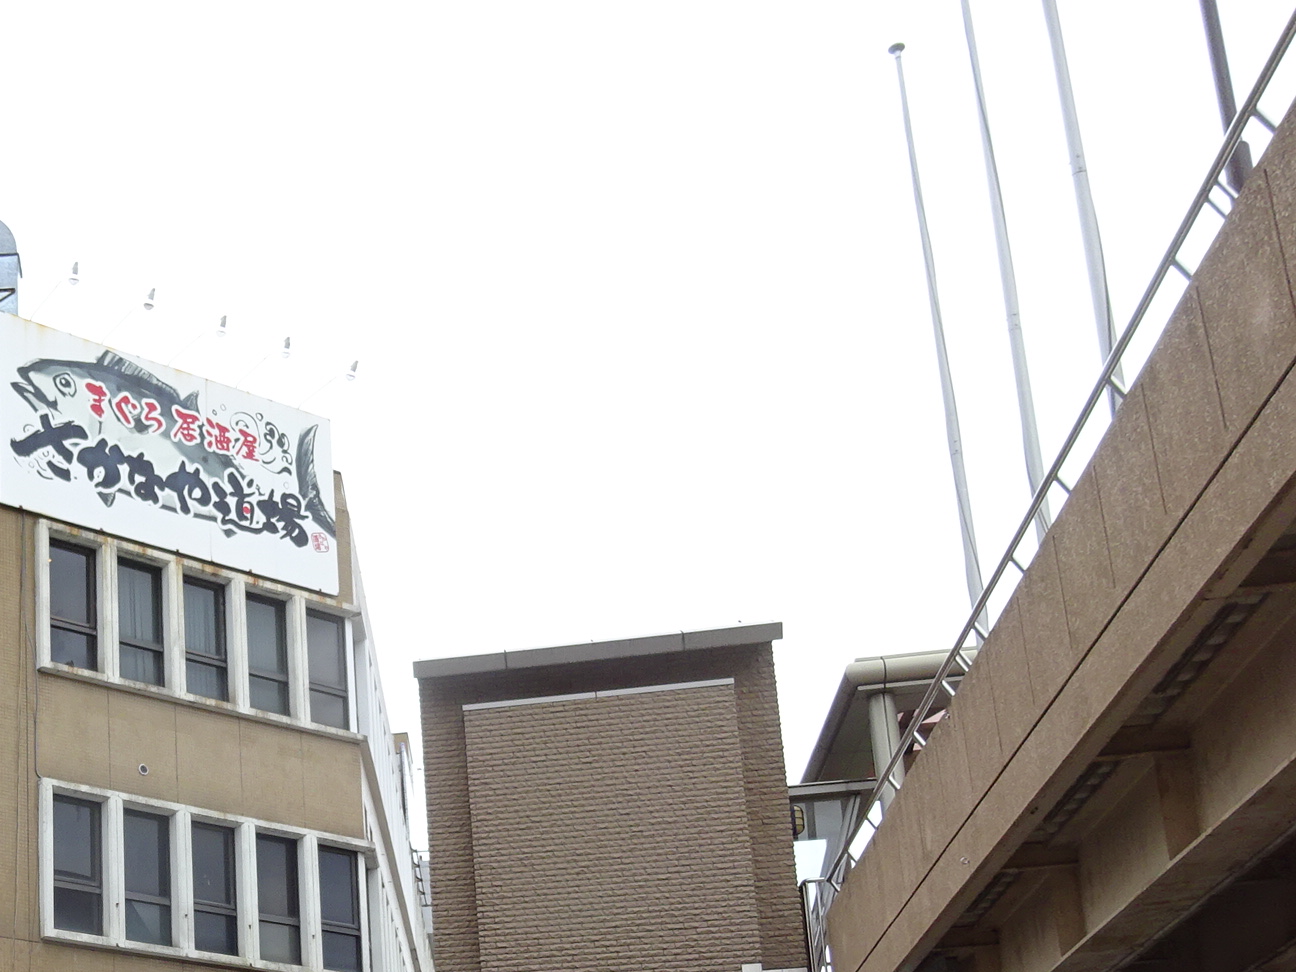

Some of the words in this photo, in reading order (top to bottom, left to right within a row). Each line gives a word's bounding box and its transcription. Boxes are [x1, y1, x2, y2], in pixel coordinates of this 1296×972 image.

[10, 413, 309, 548] さかなや道場
